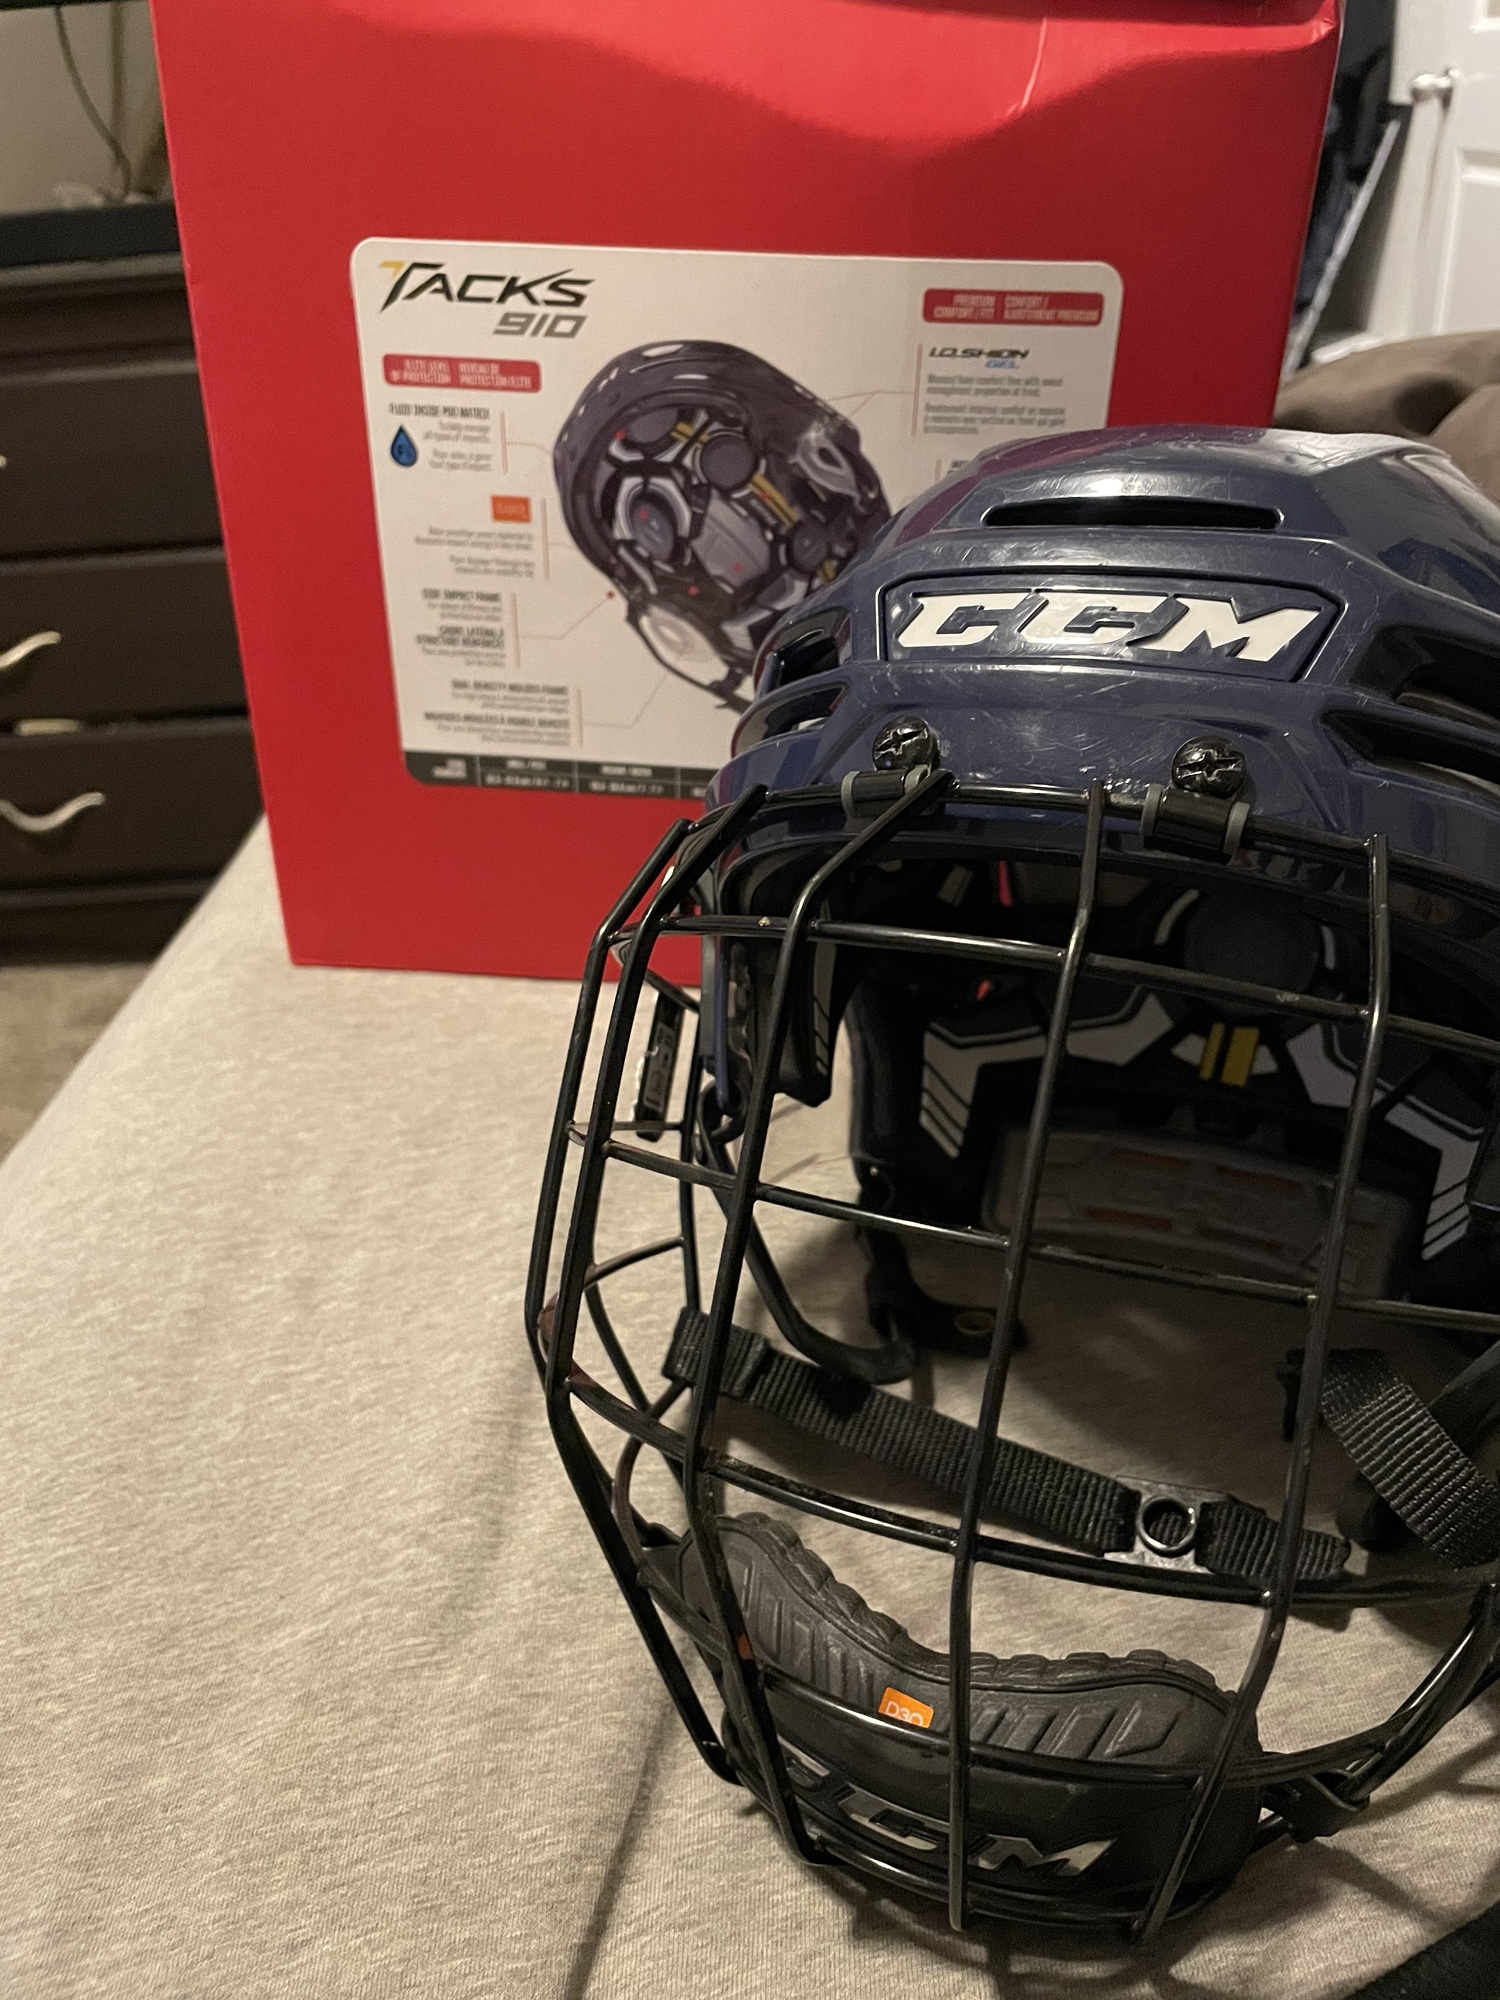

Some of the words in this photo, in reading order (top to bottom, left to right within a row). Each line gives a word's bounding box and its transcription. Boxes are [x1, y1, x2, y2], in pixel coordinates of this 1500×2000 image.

[379, 260, 596, 313] TACKS
[492, 311, 588, 339] 910
[898, 591, 1322, 662] CCM
